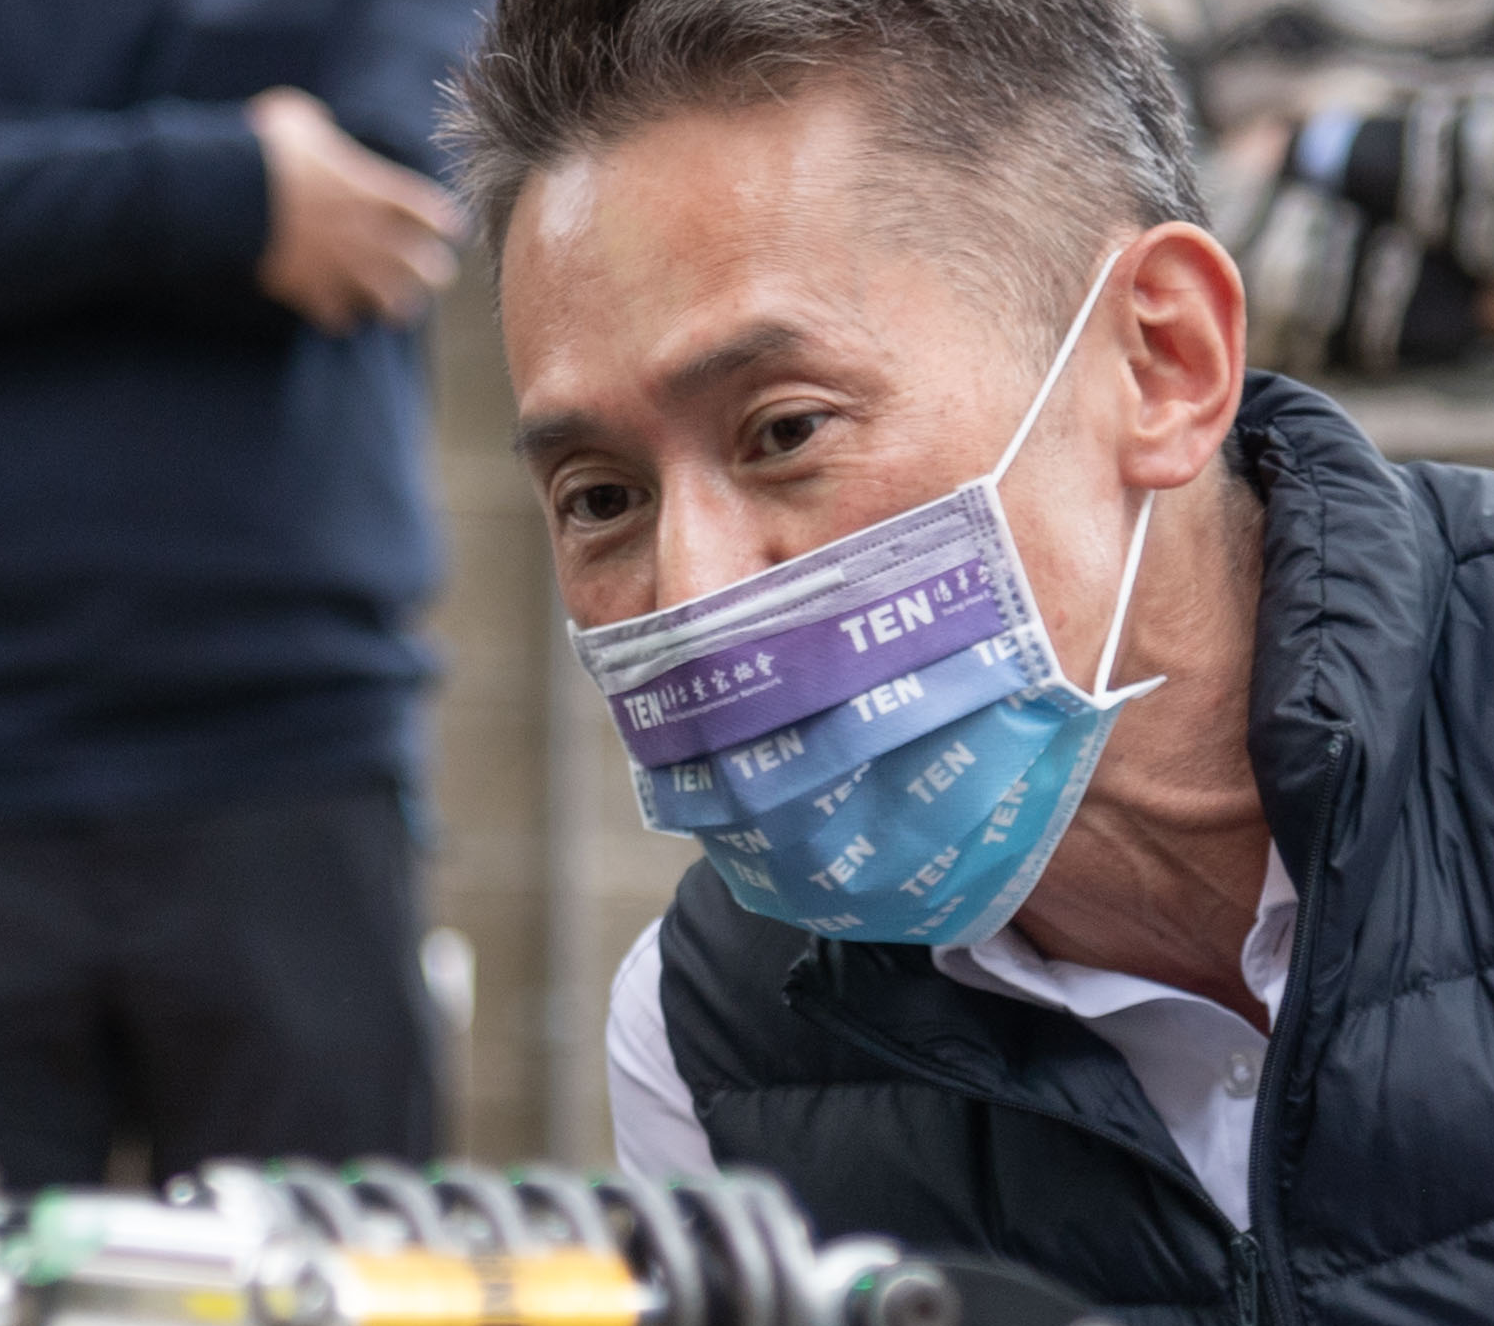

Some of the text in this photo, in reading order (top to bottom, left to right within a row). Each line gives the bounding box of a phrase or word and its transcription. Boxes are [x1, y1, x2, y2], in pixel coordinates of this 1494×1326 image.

[839, 589, 936, 654] TEN
[971, 628, 1022, 667] TE
[623, 691, 664, 732] TEN
[849, 672, 925, 723] TEN
[730, 728, 805, 780] TEN
[906, 740, 977, 805] TEN
[808, 833, 877, 892] TEN
